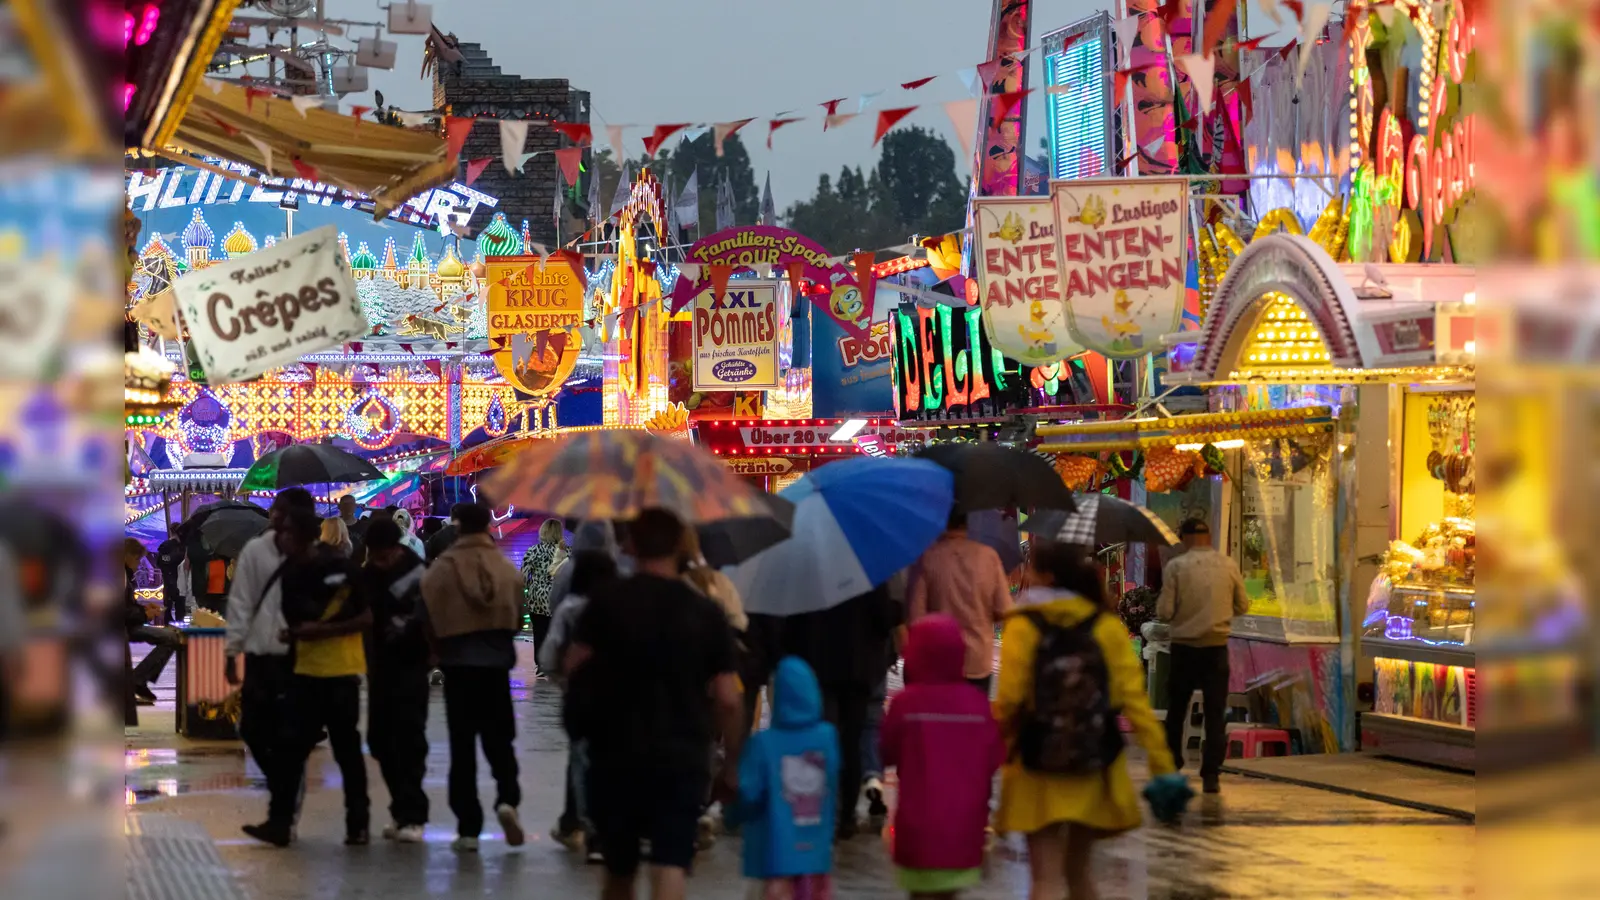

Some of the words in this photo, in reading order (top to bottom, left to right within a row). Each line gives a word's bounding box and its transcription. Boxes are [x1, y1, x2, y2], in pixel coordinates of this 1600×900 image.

[1112, 198, 1179, 225] Lustiges
[1065, 224, 1174, 264] ENTEN-
[1065, 256, 1183, 300] ANGELN
[504, 288, 569, 308] KRUG
[709, 291, 762, 310] XXL
[206, 277, 341, 342] Crêpes
[490, 313, 580, 330] GLASIERTE
[717, 367, 754, 379] Getränke
[750, 428, 790, 444] Über
[792, 430, 816, 444] 20
